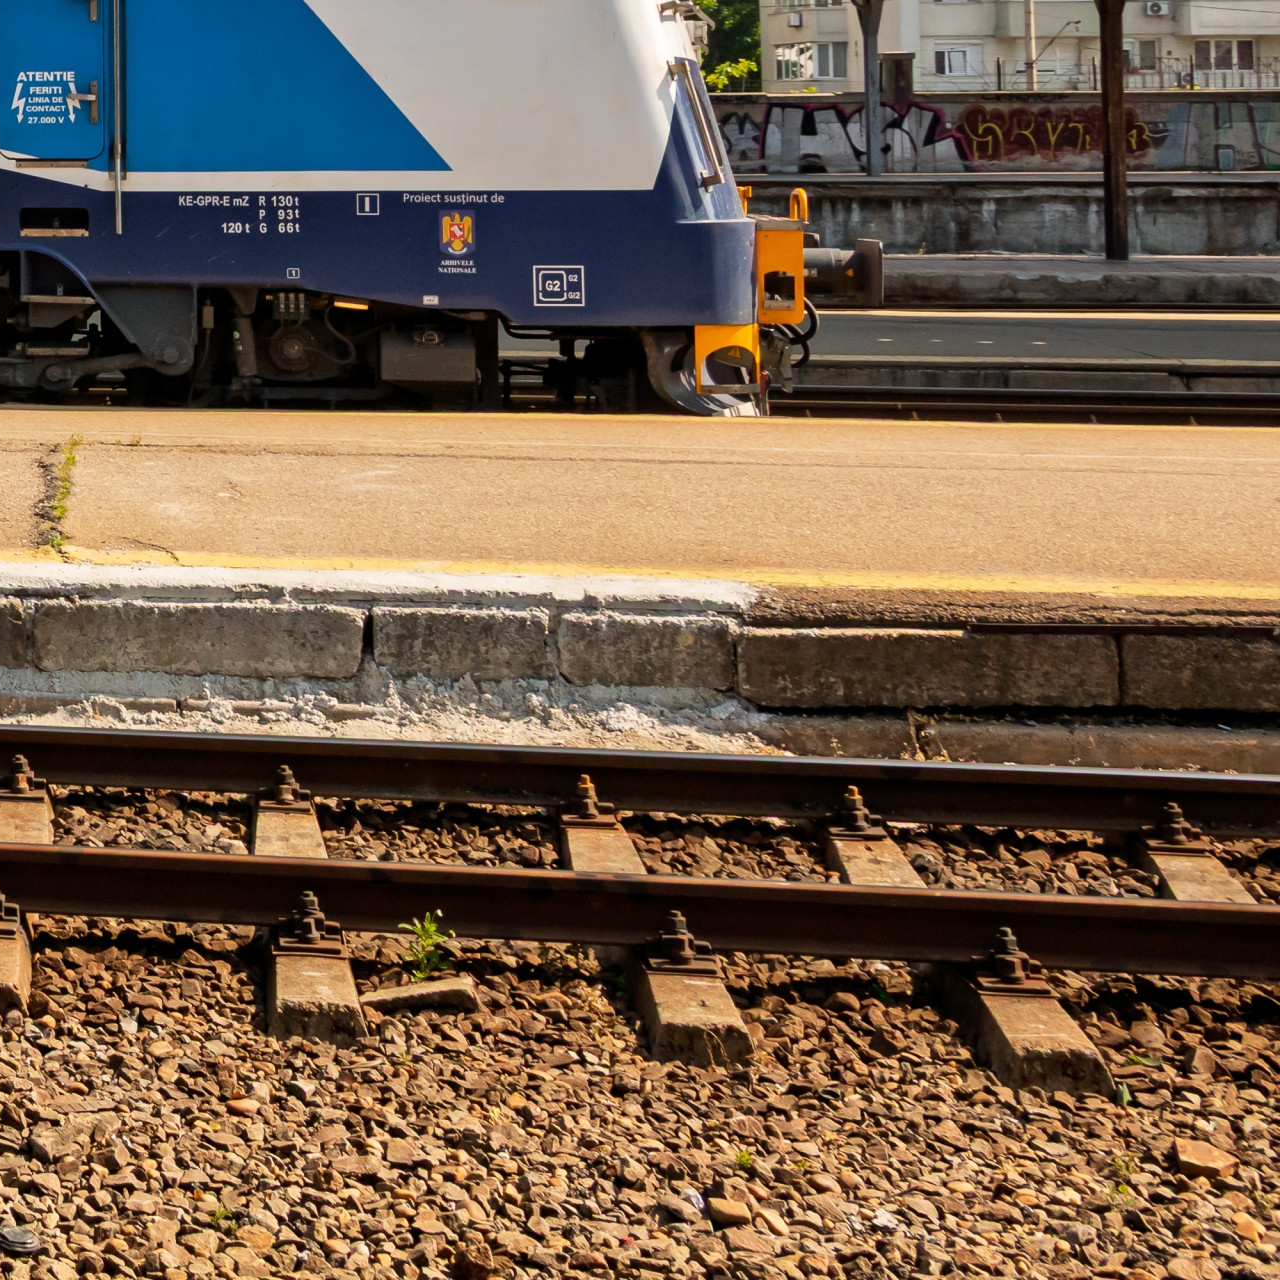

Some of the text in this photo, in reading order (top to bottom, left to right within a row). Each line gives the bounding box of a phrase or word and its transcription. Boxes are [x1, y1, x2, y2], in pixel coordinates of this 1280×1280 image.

[17, 71, 75, 81] ATENTIE
[178, 196, 230, 206] KE-GPR-E
[233, 196, 249, 206] mZ
[259, 196, 266, 206] R
[403, 193, 441, 203] Proiect
[490, 193, 505, 203] de
[259, 210, 266, 219] P
[221, 223, 242, 233] 120
[259, 223, 267, 233] G
[545, 280, 560, 291] G2
